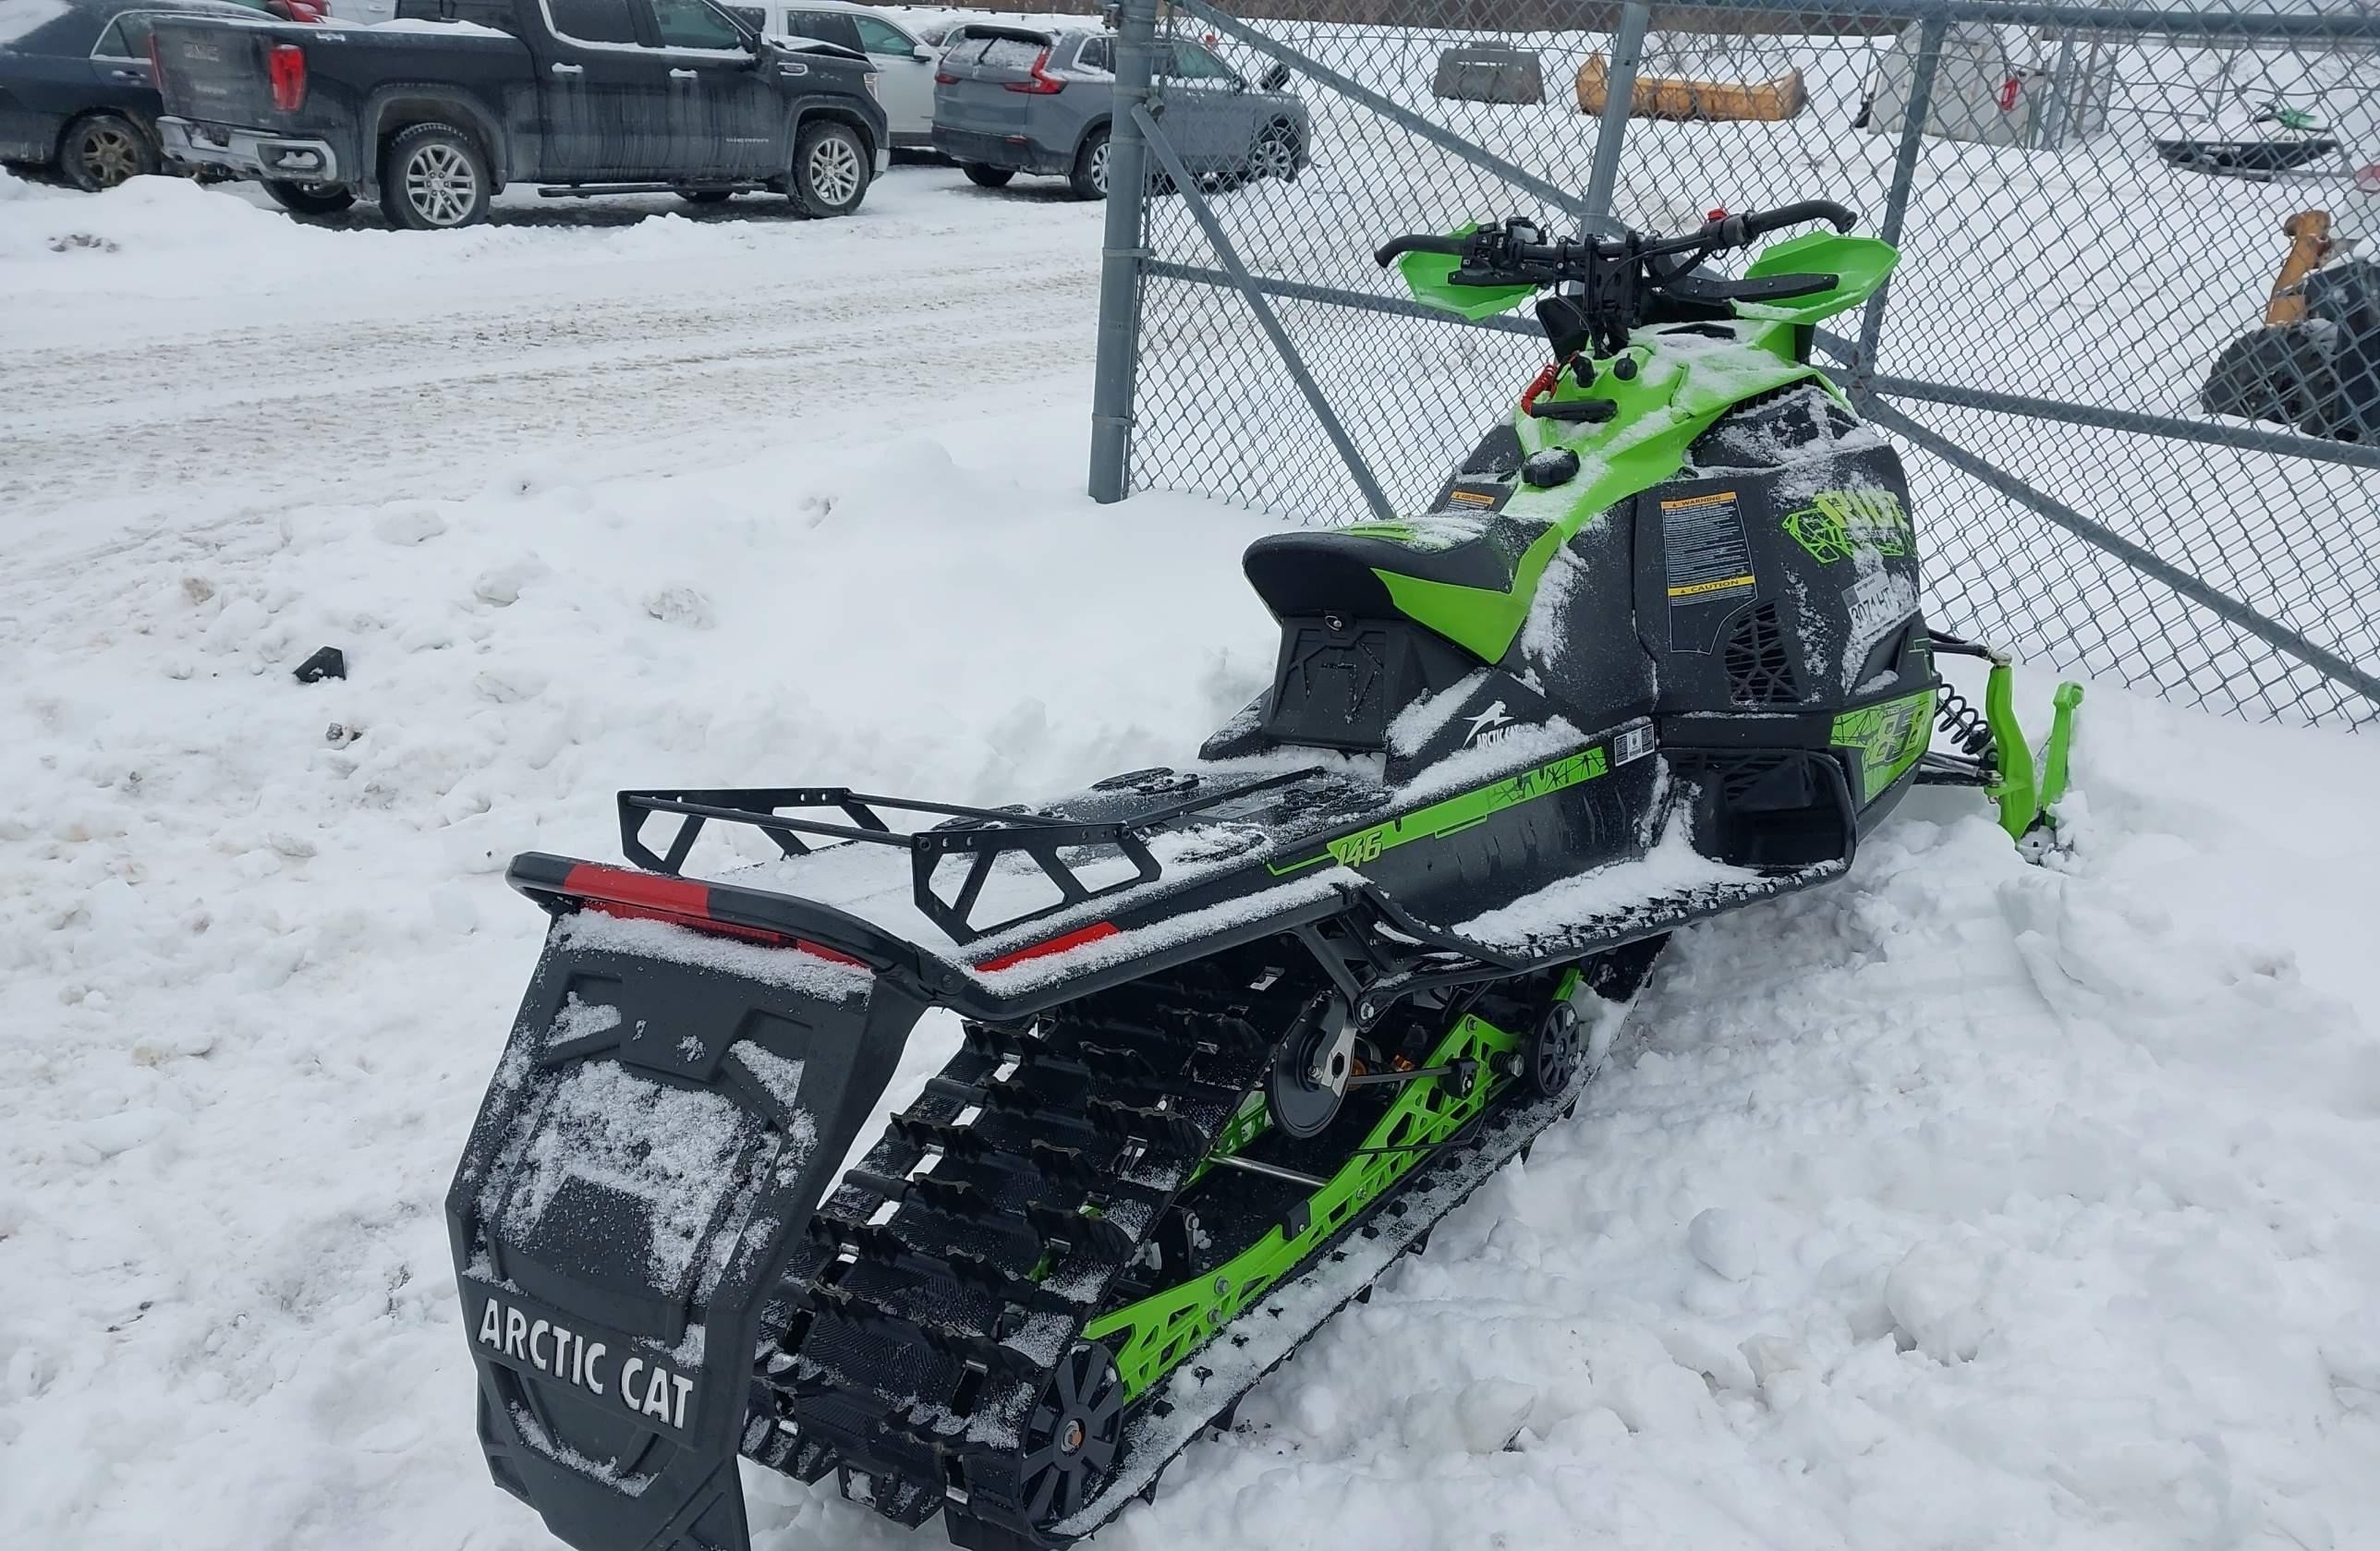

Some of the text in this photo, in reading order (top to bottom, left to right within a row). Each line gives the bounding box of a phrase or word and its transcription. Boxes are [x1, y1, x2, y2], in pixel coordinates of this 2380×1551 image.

[1682, 496, 1720, 506] WARNING
[1691, 579, 1739, 592] CAUTION
[1337, 831, 1382, 867] 146
[479, 1297, 694, 1429] ARCTIC CAT
